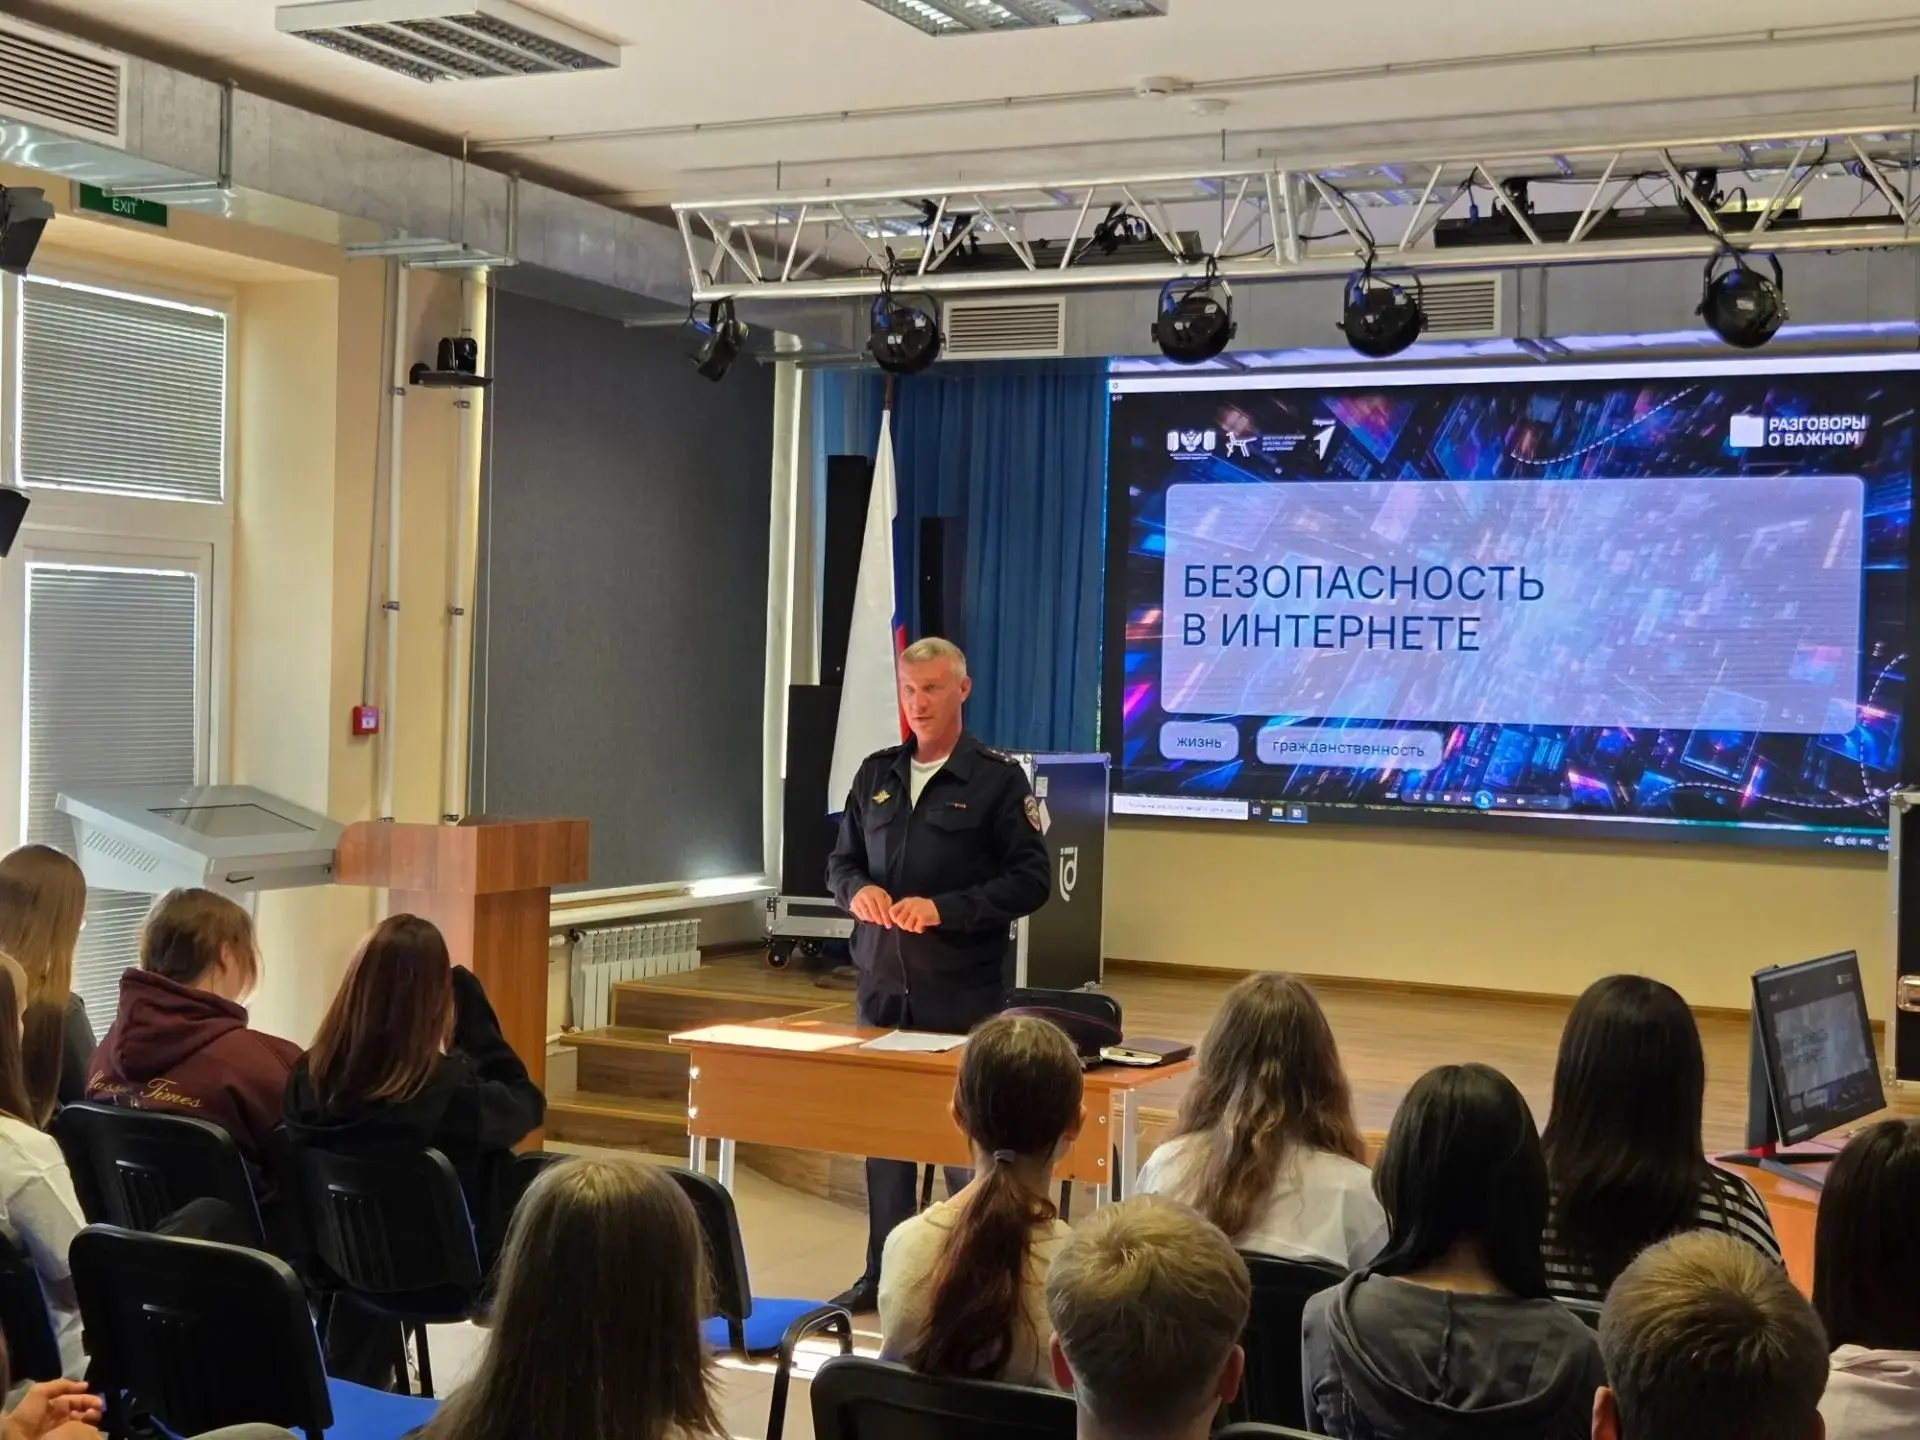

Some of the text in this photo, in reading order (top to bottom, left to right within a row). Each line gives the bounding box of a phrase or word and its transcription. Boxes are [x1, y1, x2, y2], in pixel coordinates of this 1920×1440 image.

[112, 198, 137, 214] EXIT
[1769, 415, 1866, 431] РАЗГОВОРЫ
[1768, 431, 1860, 446] О ВАЖНОМ
[1184, 564, 1545, 601] БЕЗОПАСНОСТЬ
[1182, 613, 1481, 652] В ИНТЕРНЕТЕ
[1176, 736, 1425, 758] жизнь гражданственность
[139, 1077, 202, 1108] Times
